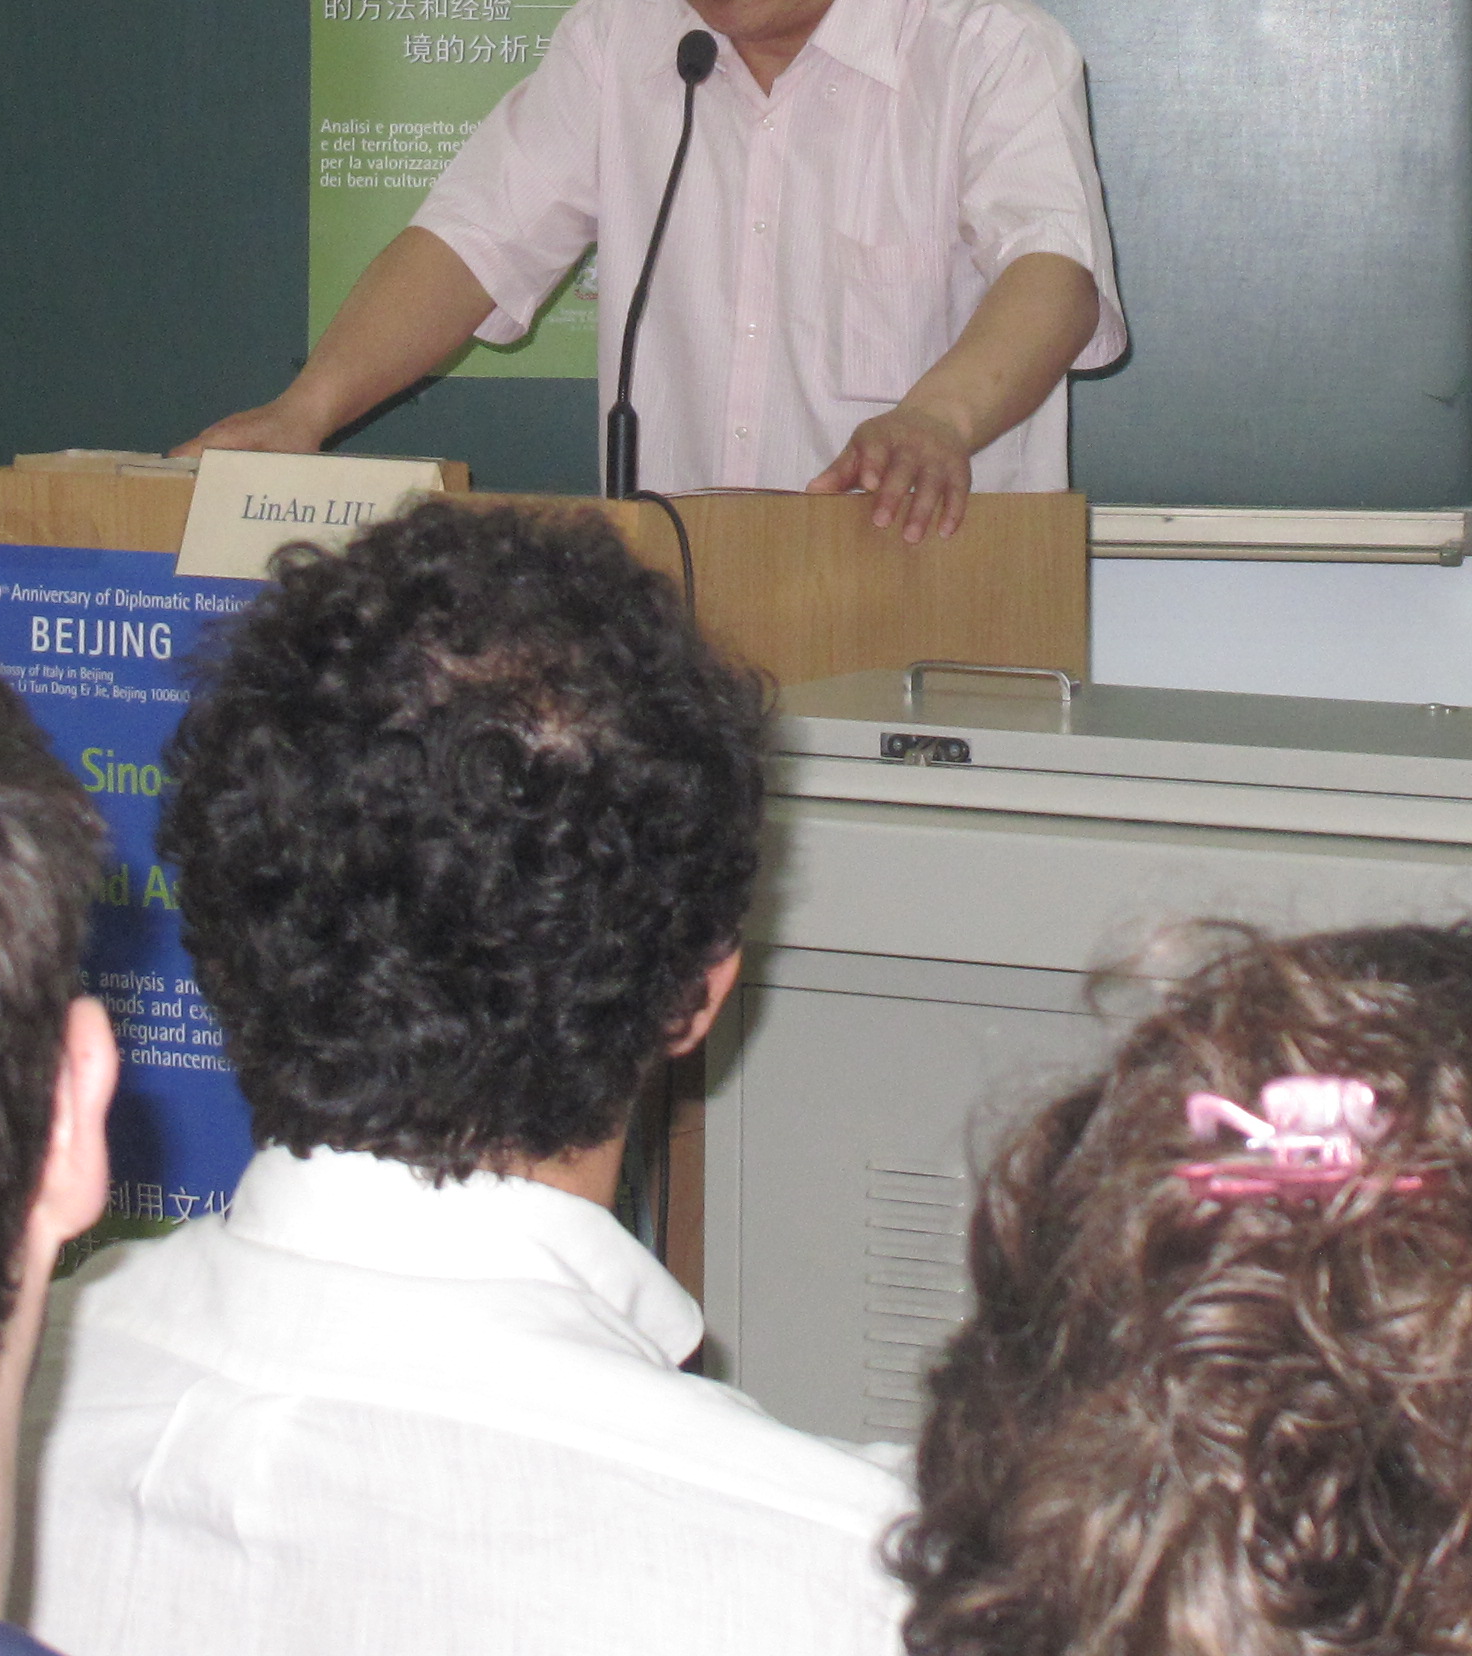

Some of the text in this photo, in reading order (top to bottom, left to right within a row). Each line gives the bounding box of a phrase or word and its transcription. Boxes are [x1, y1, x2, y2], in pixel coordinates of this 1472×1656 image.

[321, 119, 369, 134] Analisi
[376, 124, 384, 134] e
[389, 121, 454, 139] progetto
[321, 142, 328, 152] e
[334, 138, 355, 152] del
[321, 159, 342, 173] per
[349, 156, 361, 170] la
[320, 173, 439, 187] dei beni cultura
[242, 494, 316, 523] LinAn
[11, 585, 91, 609] Anniversary
[96, 588, 111, 606] of
[115, 589, 190, 612] Diplomatic
[31, 615, 173, 660] BEIJING
[43, 665, 65, 681] Italy
[80, 667, 114, 683] Beijing
[30, 681, 48, 693] Tun
[52, 682, 77, 699] Dong
[114, 686, 147, 703] Beijing
[99, 969, 165, 995] analysis
[152, 998, 182, 1018] and
[192, 1028, 223, 1046] and
